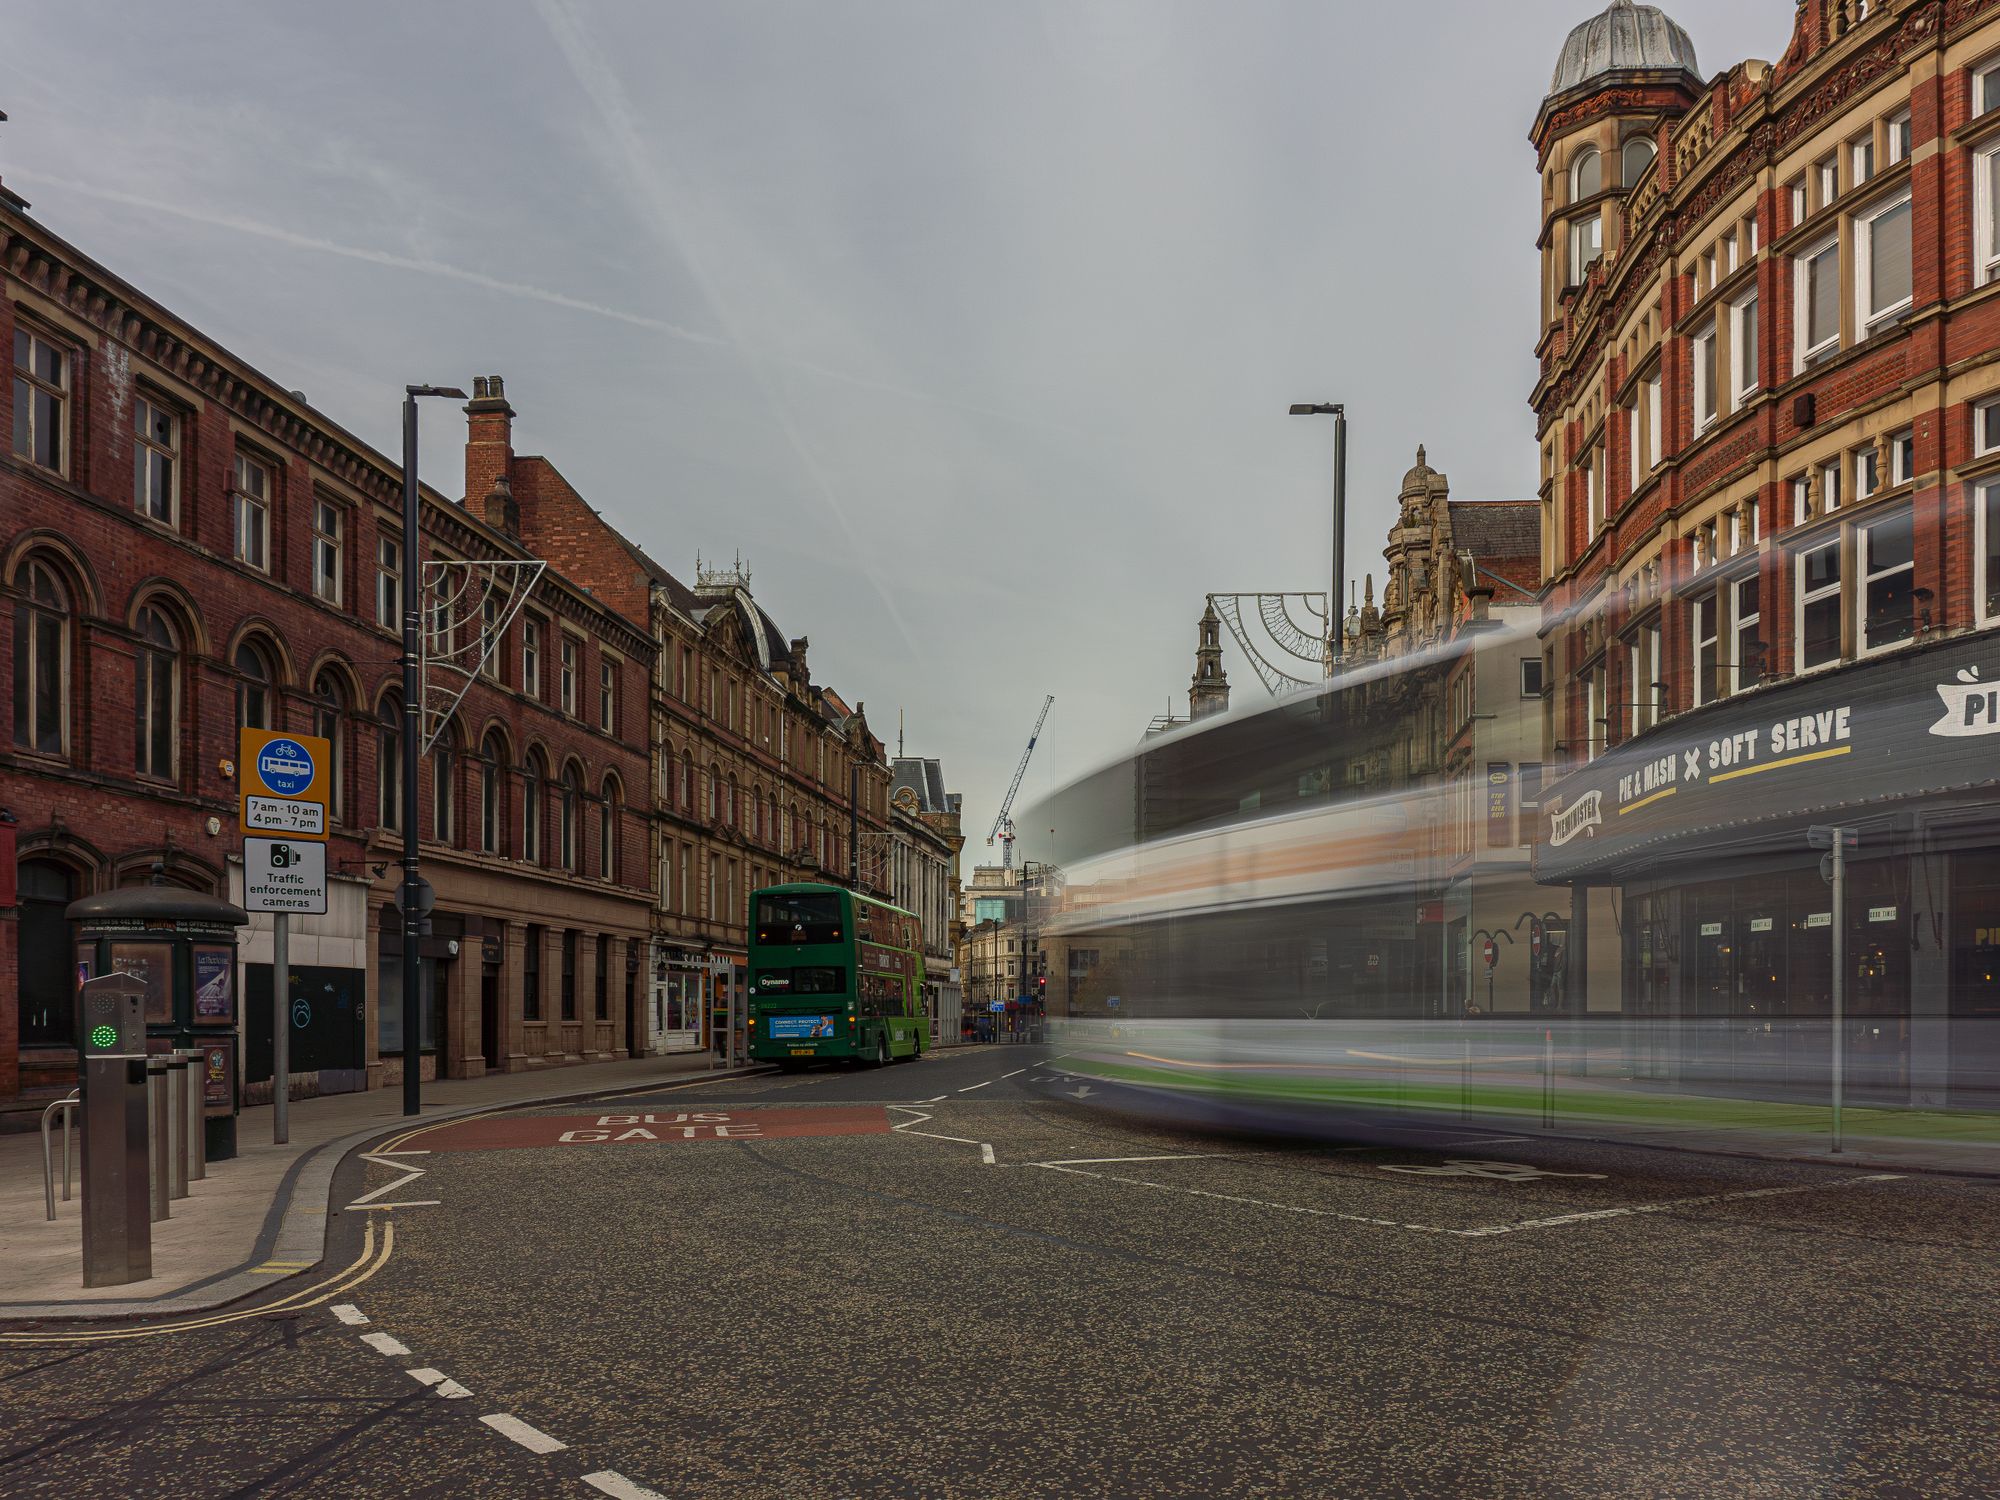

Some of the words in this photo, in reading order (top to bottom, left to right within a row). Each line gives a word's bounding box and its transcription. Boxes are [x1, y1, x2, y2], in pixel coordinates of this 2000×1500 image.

[1619, 773, 1633, 804] PIE
[1635, 770, 1642, 797] &
[1644, 754, 1677, 793] MASH
[1708, 729, 1759, 770] SOFT
[1771, 706, 1851, 754] SERVE
[277, 779, 295, 789] taxi
[251, 801, 259, 810] 7
[261, 803, 278, 812] am
[287, 804, 300, 814] 10
[302, 808, 319, 816] am
[253, 813, 262, 822] 4
[264, 816, 282, 825] pm
[290, 816, 298, 826] 7
[299, 819, 317, 828] pm
[1555, 796, 1597, 841] PIEMINISTER
[267, 873, 304, 884] Traffic
[250, 885, 322, 897] enforcement
[262, 898, 310, 908] cameras
[597, 1113, 731, 1126] BUS
[559, 1124, 764, 1143] GATE
